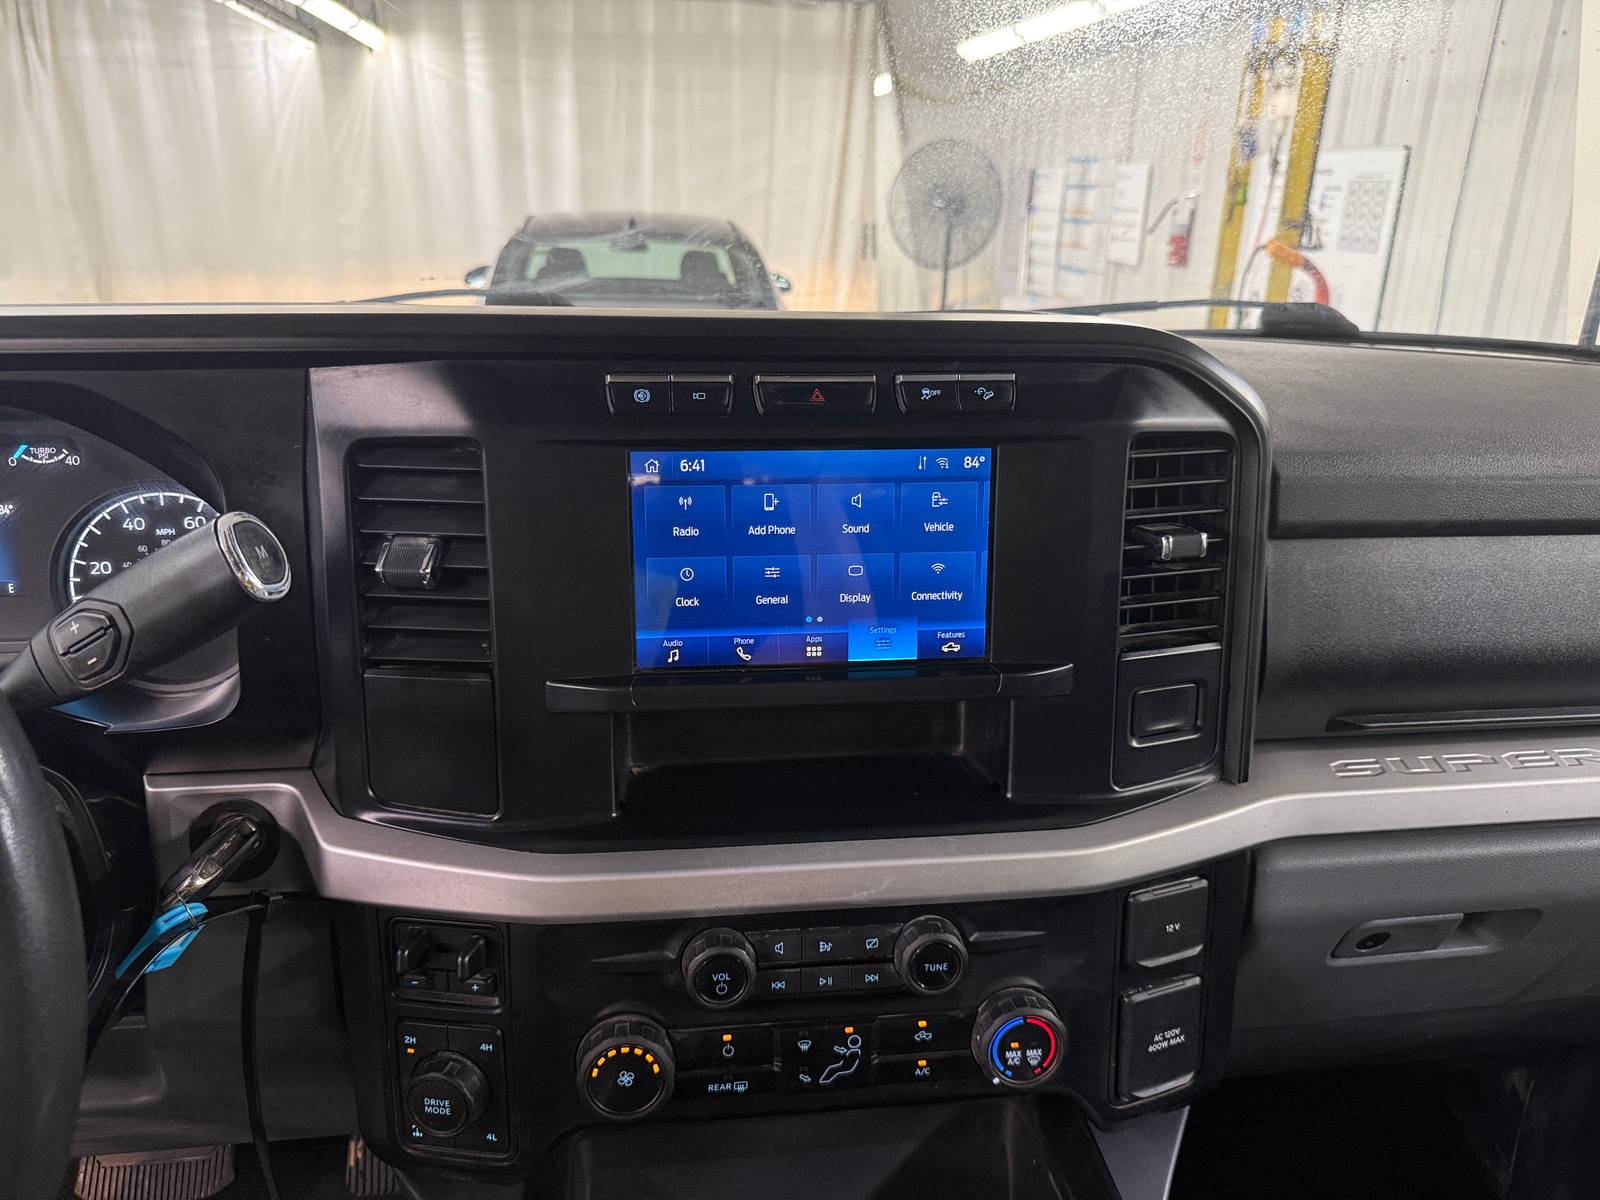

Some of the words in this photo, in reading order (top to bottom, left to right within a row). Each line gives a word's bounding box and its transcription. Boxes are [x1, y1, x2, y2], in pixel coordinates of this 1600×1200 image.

[8, 457, 17, 467] 0
[65, 455, 80, 466] 40
[680, 459, 705, 472] 6:41
[964, 456, 985, 469] 84°
[123, 518, 145, 531] 40
[842, 524, 869, 534] Sound
[924, 522, 954, 532] Vehicle
[673, 526, 699, 537] Radio
[748, 525, 766, 535] Add
[768, 525, 796, 535] Phone
[257, 545, 267, 558] M
[91, 562, 112, 575] 20
[9, 583, 15, 593] E
[756, 595, 788, 605] General
[840, 593, 871, 604] Display
[911, 590, 963, 602] Connectivity
[676, 597, 699, 607] Clock
[869, 625, 897, 635] Settings
[937, 631, 965, 639] Features
[663, 639, 683, 647] Audio
[733, 637, 754, 645] Phone
[806, 635, 823, 645] Apps
[924, 963, 948, 972] TUNE
[712, 973, 731, 981] VOL
[1154, 1033, 1164, 1042] AC
[1165, 1027, 1180, 1038] 120V
[404, 1036, 416, 1044] 2H
[1148, 1039, 1169, 1053] 400W
[1169, 1034, 1185, 1046] MAX
[480, 1043, 493, 1051] 4H
[1005, 1050, 1022, 1059] MAX
[1026, 1048, 1042, 1057] MAX
[1007, 1057, 1020, 1066] A/C
[915, 1067, 930, 1077] A/C
[707, 1083, 732, 1093] REAR
[424, 1098, 450, 1107] DRIVE
[424, 1106, 451, 1115] MODE
[486, 1133, 497, 1141] 4L
